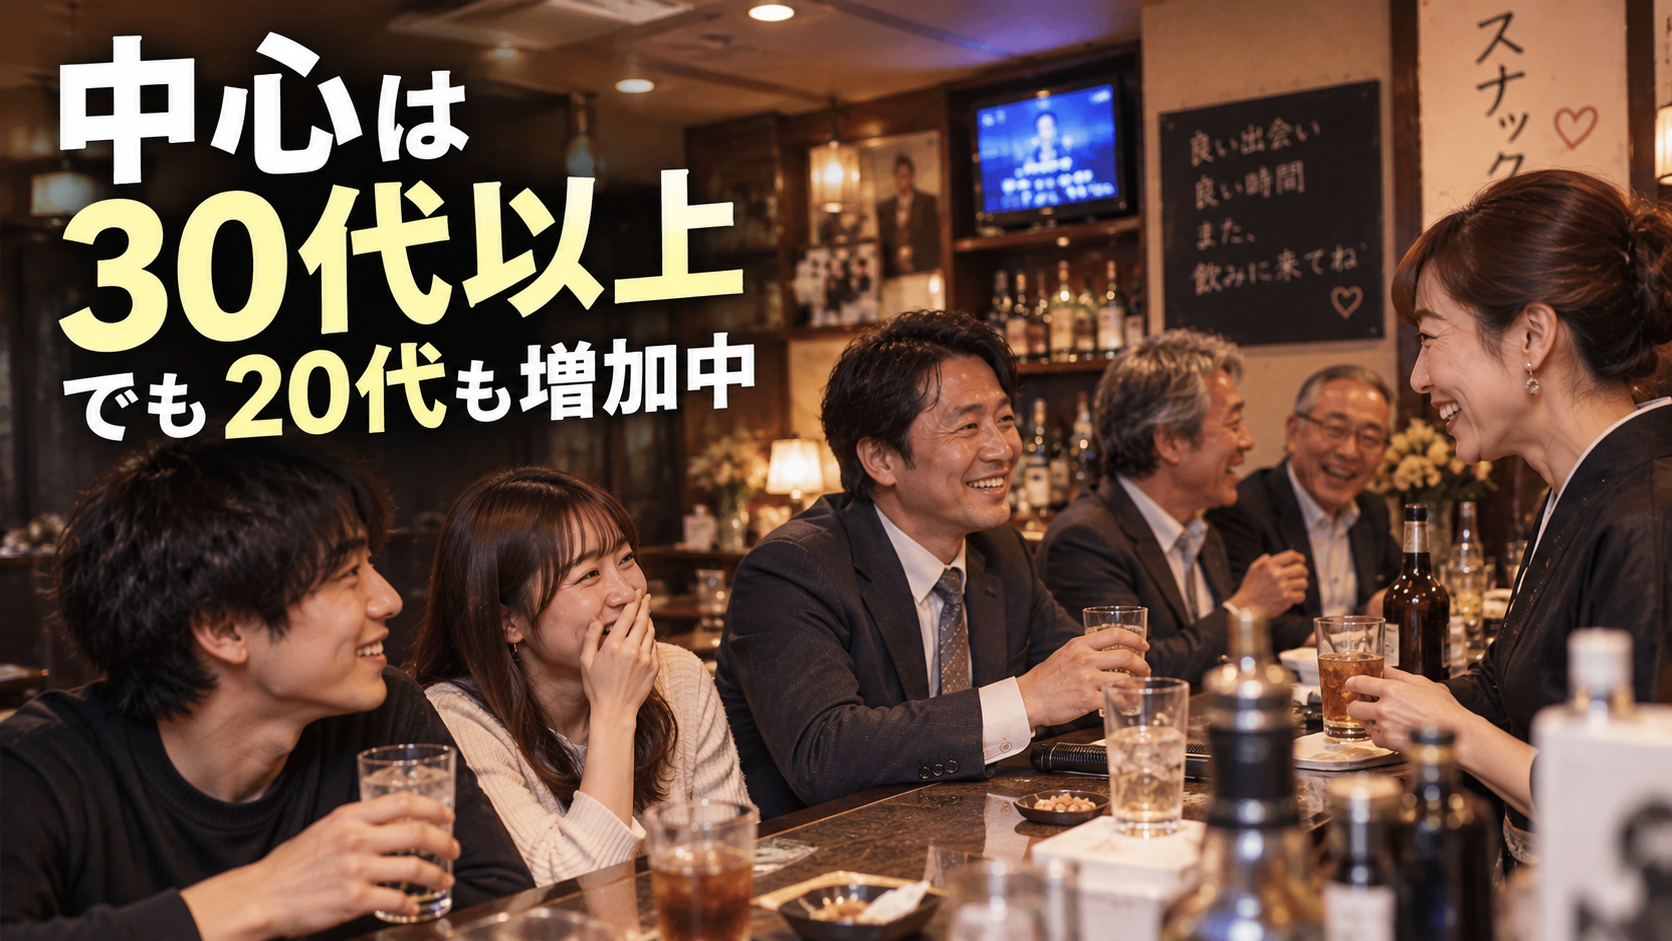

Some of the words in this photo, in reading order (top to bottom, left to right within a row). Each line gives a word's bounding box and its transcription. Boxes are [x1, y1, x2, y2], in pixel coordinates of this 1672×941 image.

[1190, 117, 1321, 167] 良い出会い
[1195, 160, 1305, 210] 良い時間
[1191, 244, 1359, 295] 飲みに来てね
